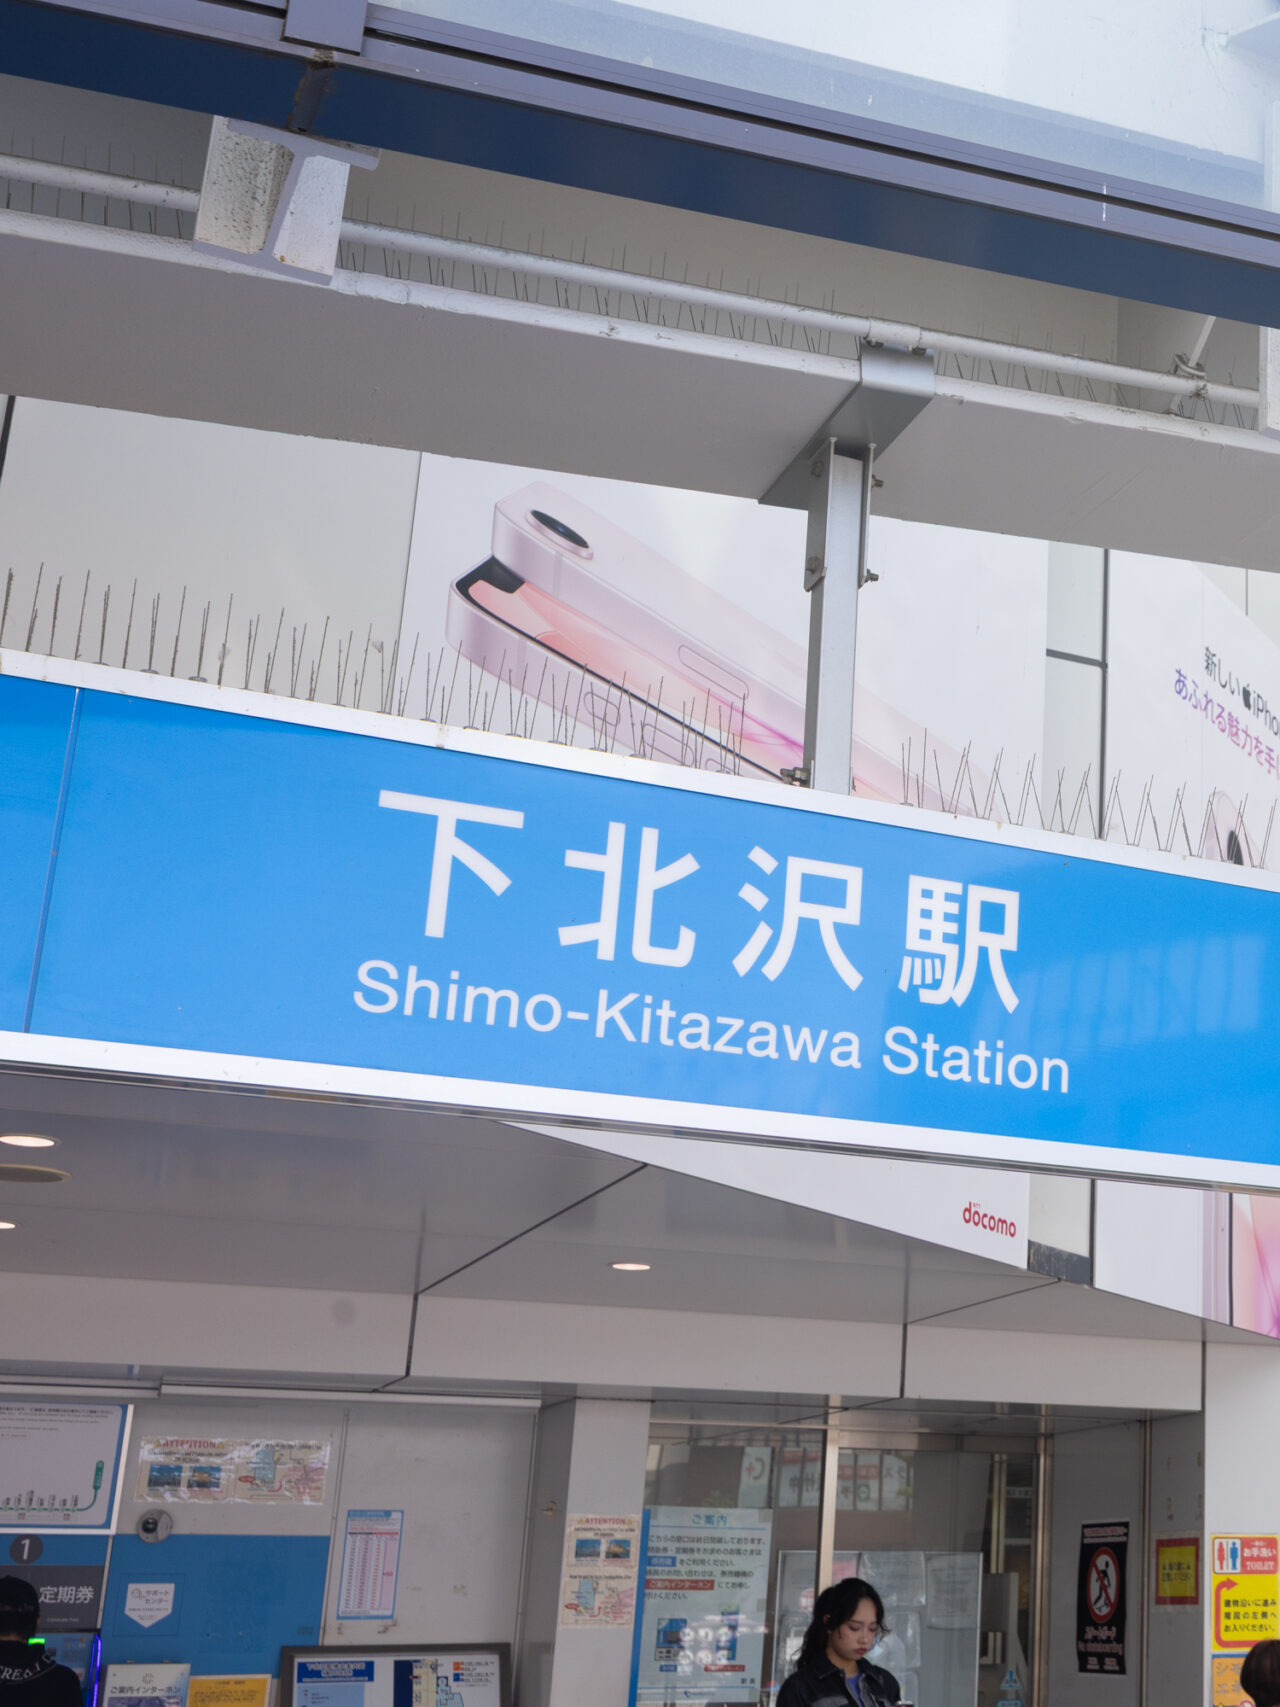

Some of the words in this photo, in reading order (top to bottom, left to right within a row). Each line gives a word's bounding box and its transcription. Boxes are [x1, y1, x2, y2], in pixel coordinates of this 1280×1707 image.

[378, 789, 1020, 1014] 下北沢駅
[353, 958, 862, 1070] Shimo-Kitazawa
[882, 1024, 1069, 1095] Station
[691, 1514, 728, 1526] ご案内
[21, 1539, 31, 1560] 1
[39, 1585, 95, 1604] 定期券
